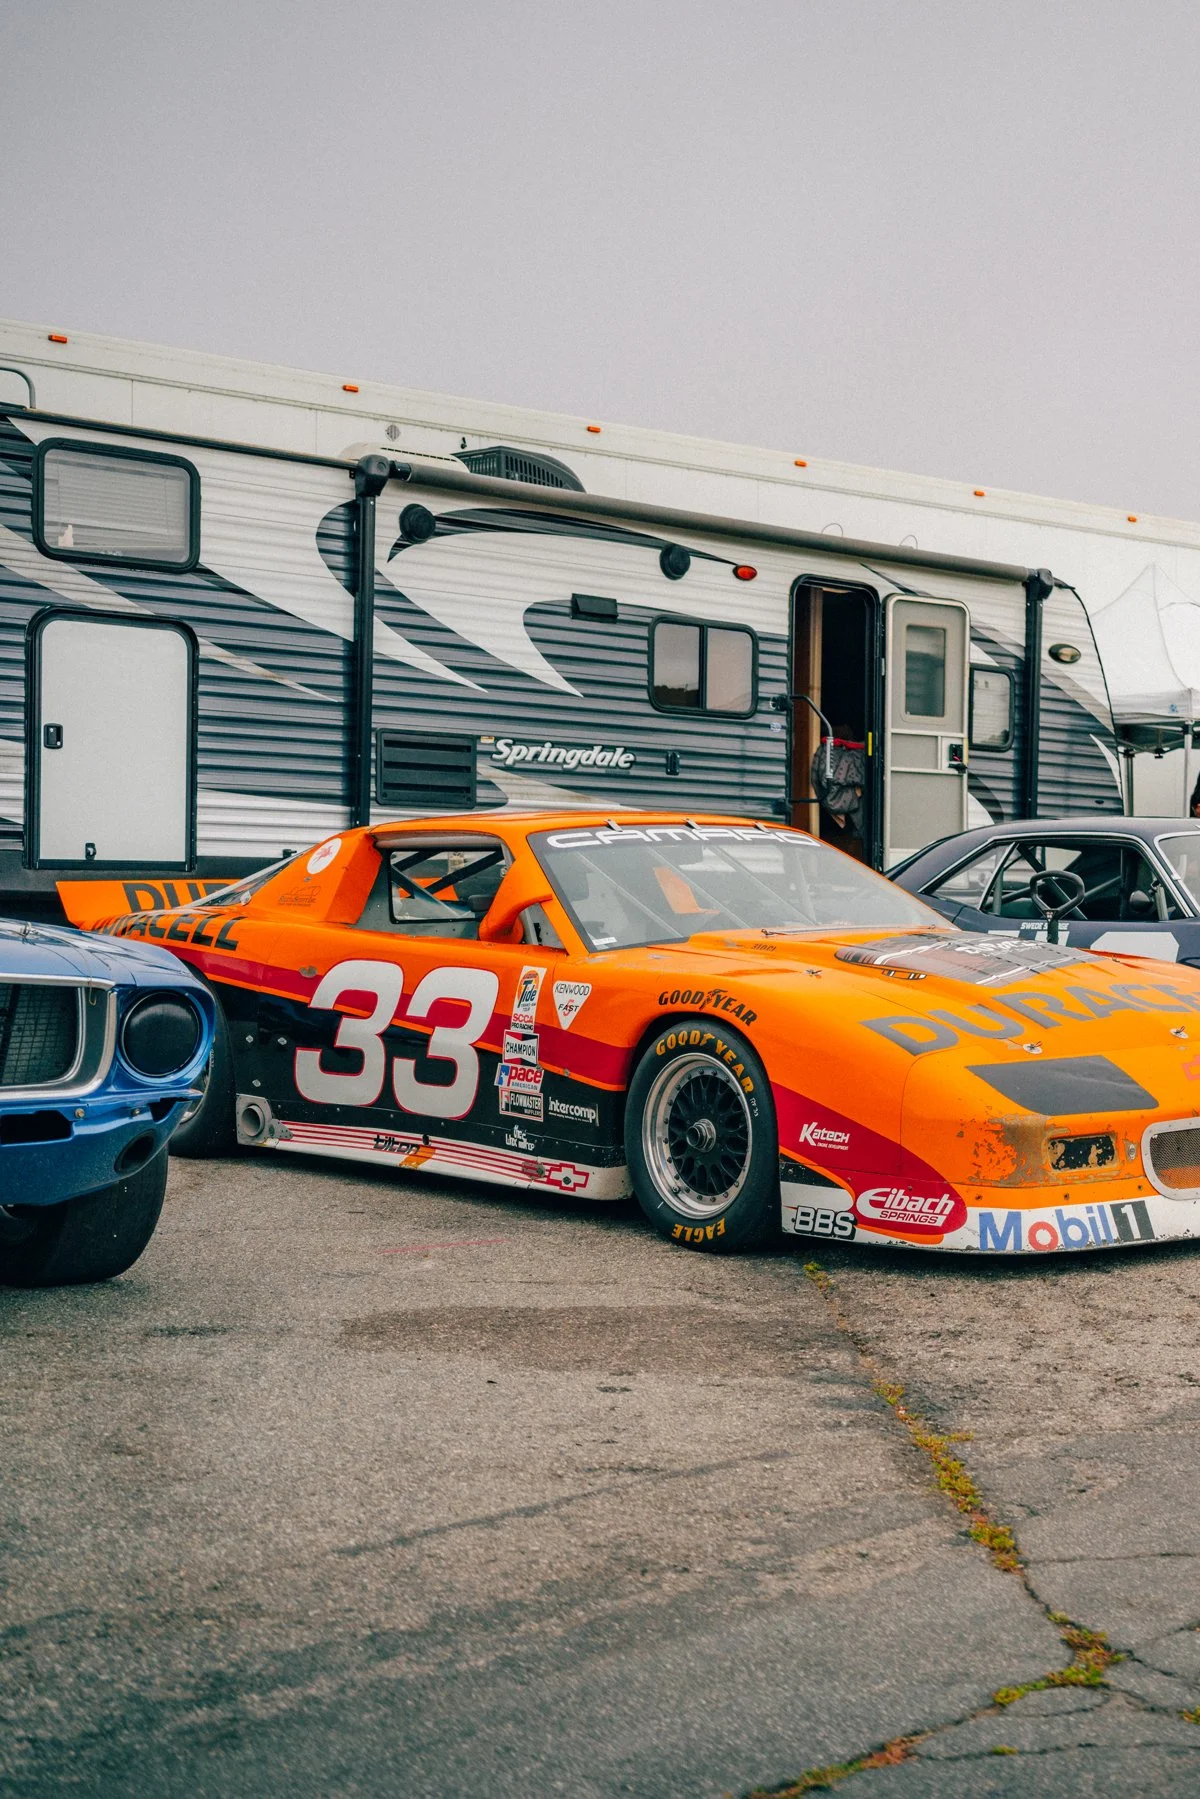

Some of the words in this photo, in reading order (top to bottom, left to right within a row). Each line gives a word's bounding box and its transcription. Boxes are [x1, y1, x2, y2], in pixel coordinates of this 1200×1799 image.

[491, 738, 635, 771] Springdale
[547, 828, 821, 848] CAMARO
[1020, 922, 1043, 930] SWEDE
[517, 980, 537, 1008] Tide
[555, 983, 590, 996] KENWOOD
[558, 1003, 579, 1012] FAST
[513, 1013, 533, 1024] SCCA
[294, 958, 499, 1120] 33
[505, 1042, 536, 1057] CHAMPION
[506, 1065, 542, 1087] pace
[510, 1092, 541, 1110] FLOWMASTER
[373, 1134, 422, 1155] tilton
[856, 1187, 954, 1219] Eibach
[795, 1206, 856, 1236] BBS
[879, 1209, 939, 1225] SPRINGS
[978, 1205, 1113, 1252] Mobil
[1121, 1203, 1147, 1240] 1
[671, 1217, 726, 1243] EAGLE
